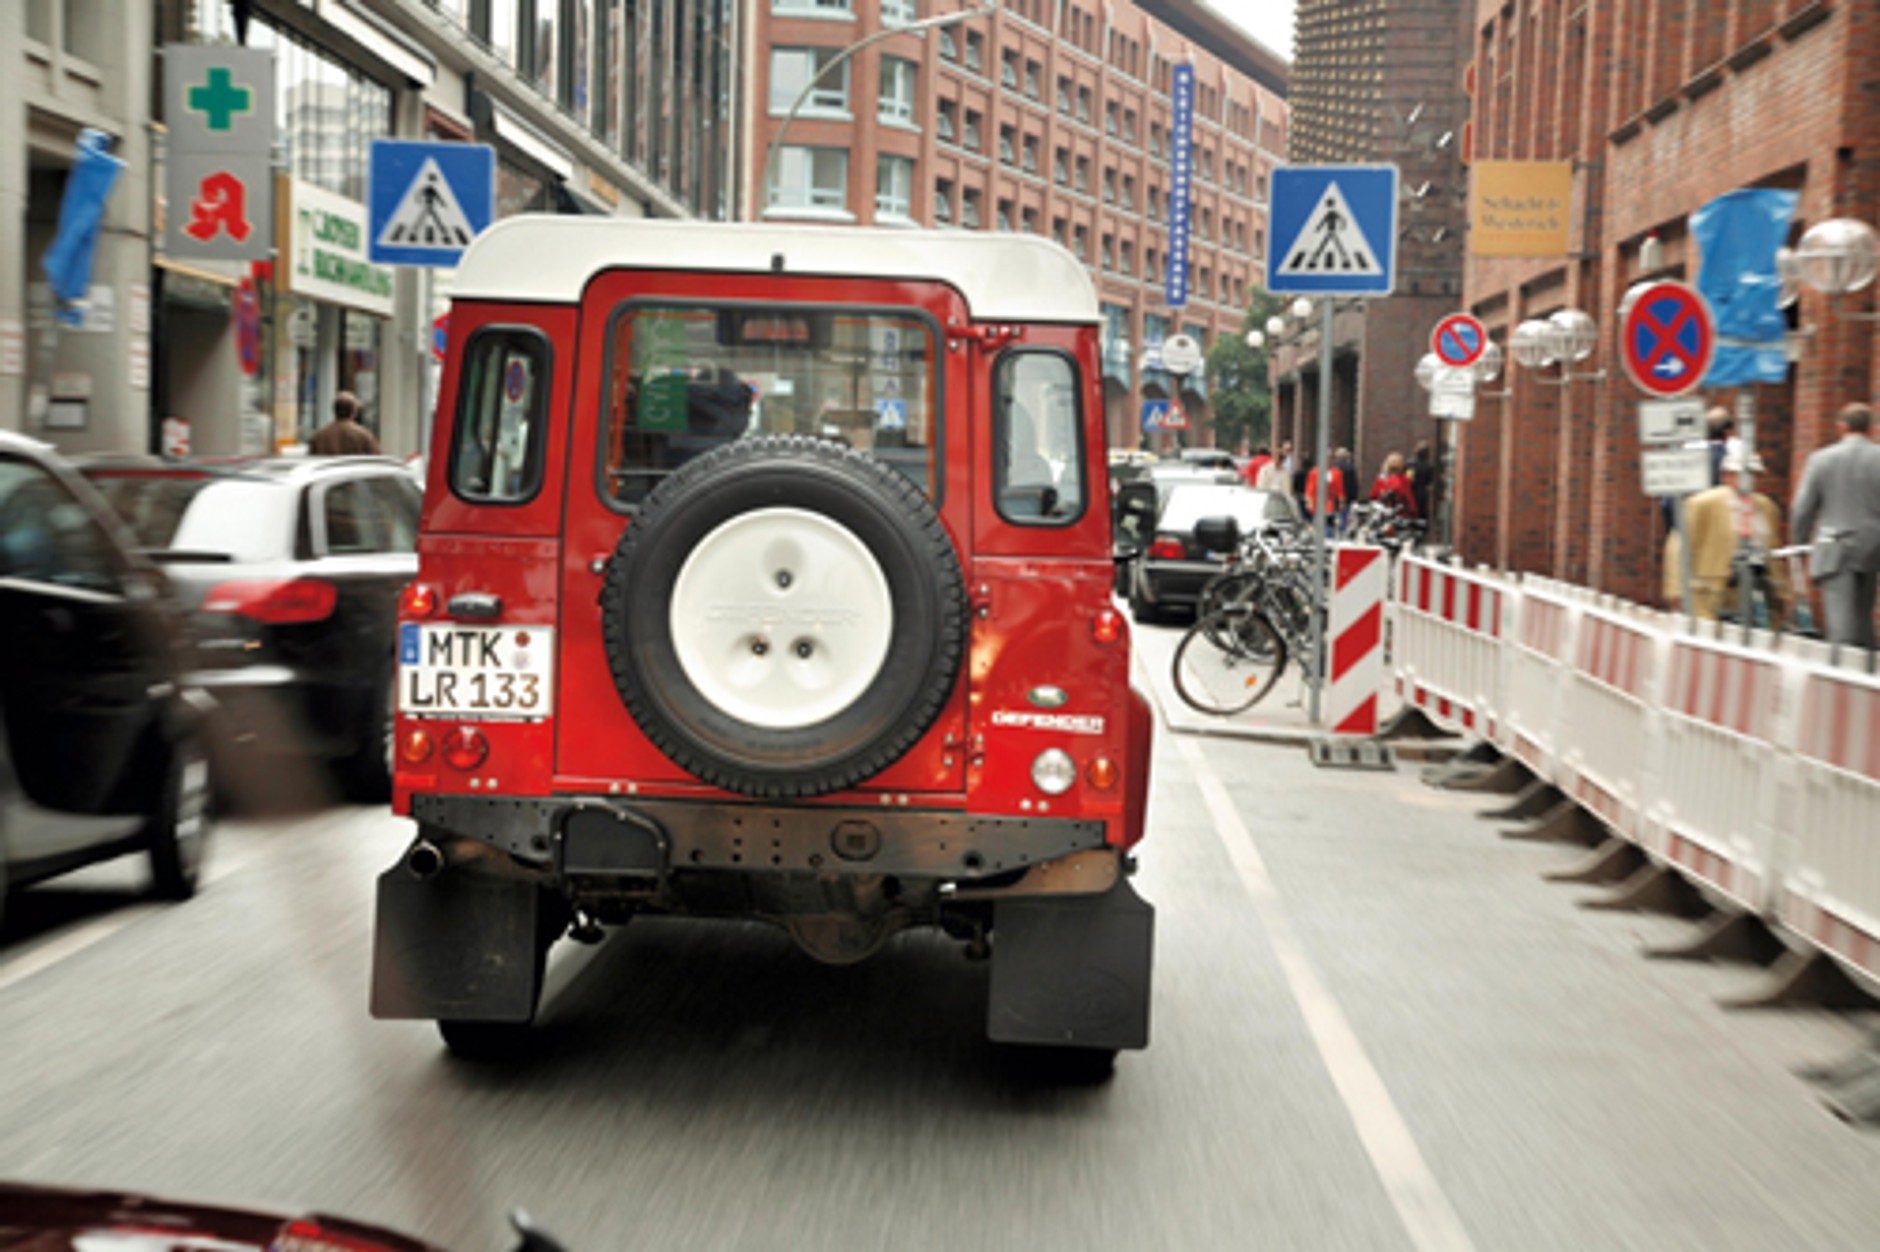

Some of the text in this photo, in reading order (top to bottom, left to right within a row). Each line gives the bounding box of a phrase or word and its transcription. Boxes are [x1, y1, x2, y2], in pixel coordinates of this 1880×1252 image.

[429, 631, 502, 667] MTK
[410, 671, 539, 709] LR 133
[992, 711, 1104, 735] DEFENDER
